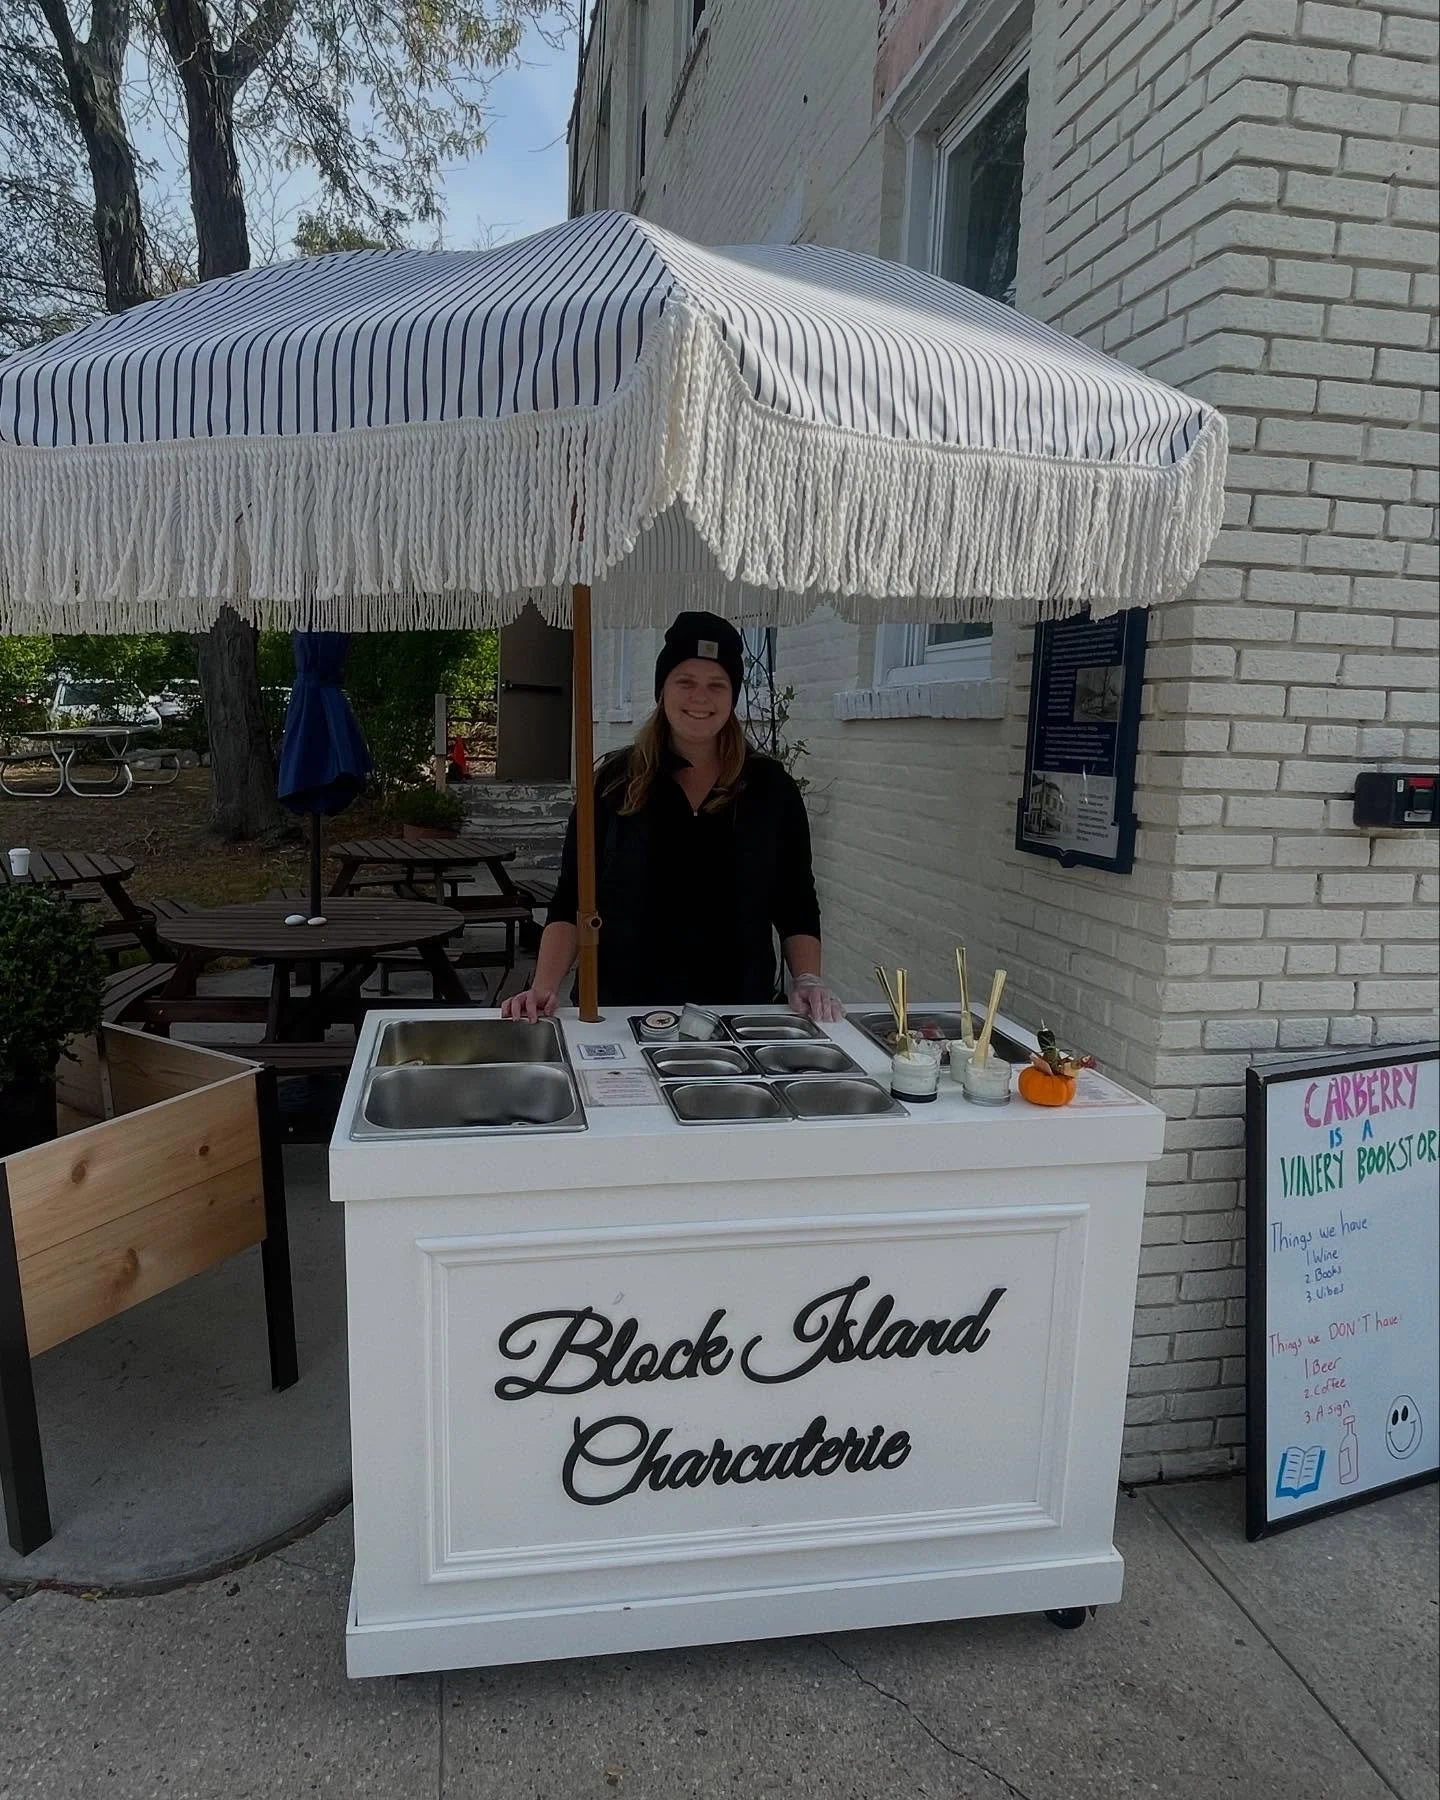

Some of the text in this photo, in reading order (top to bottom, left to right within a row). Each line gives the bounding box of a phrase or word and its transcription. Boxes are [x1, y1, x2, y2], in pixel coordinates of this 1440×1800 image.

[1304, 1064, 1418, 1128] CARBERRY
[1329, 1119, 1374, 1149] IS A
[1357, 1129, 1440, 1184] BOOKSTOR
[1271, 1210, 1369, 1253] Things we have
[1312, 1248, 1339, 1264] Wine
[1314, 1265, 1342, 1282] Books
[1316, 1283, 1344, 1299] Vibes
[494, 1275, 1007, 1401] Block Island
[1269, 1332, 1302, 1358] Things
[1308, 1335, 1321, 1345] we
[1375, 1311, 1399, 1331] have
[1312, 1356, 1342, 1376] Beer
[1314, 1378, 1346, 1396] Coffee
[1316, 1404, 1324, 1423] A
[1327, 1399, 1351, 1417] sign
[561, 1415, 912, 1506] Charcuterie
